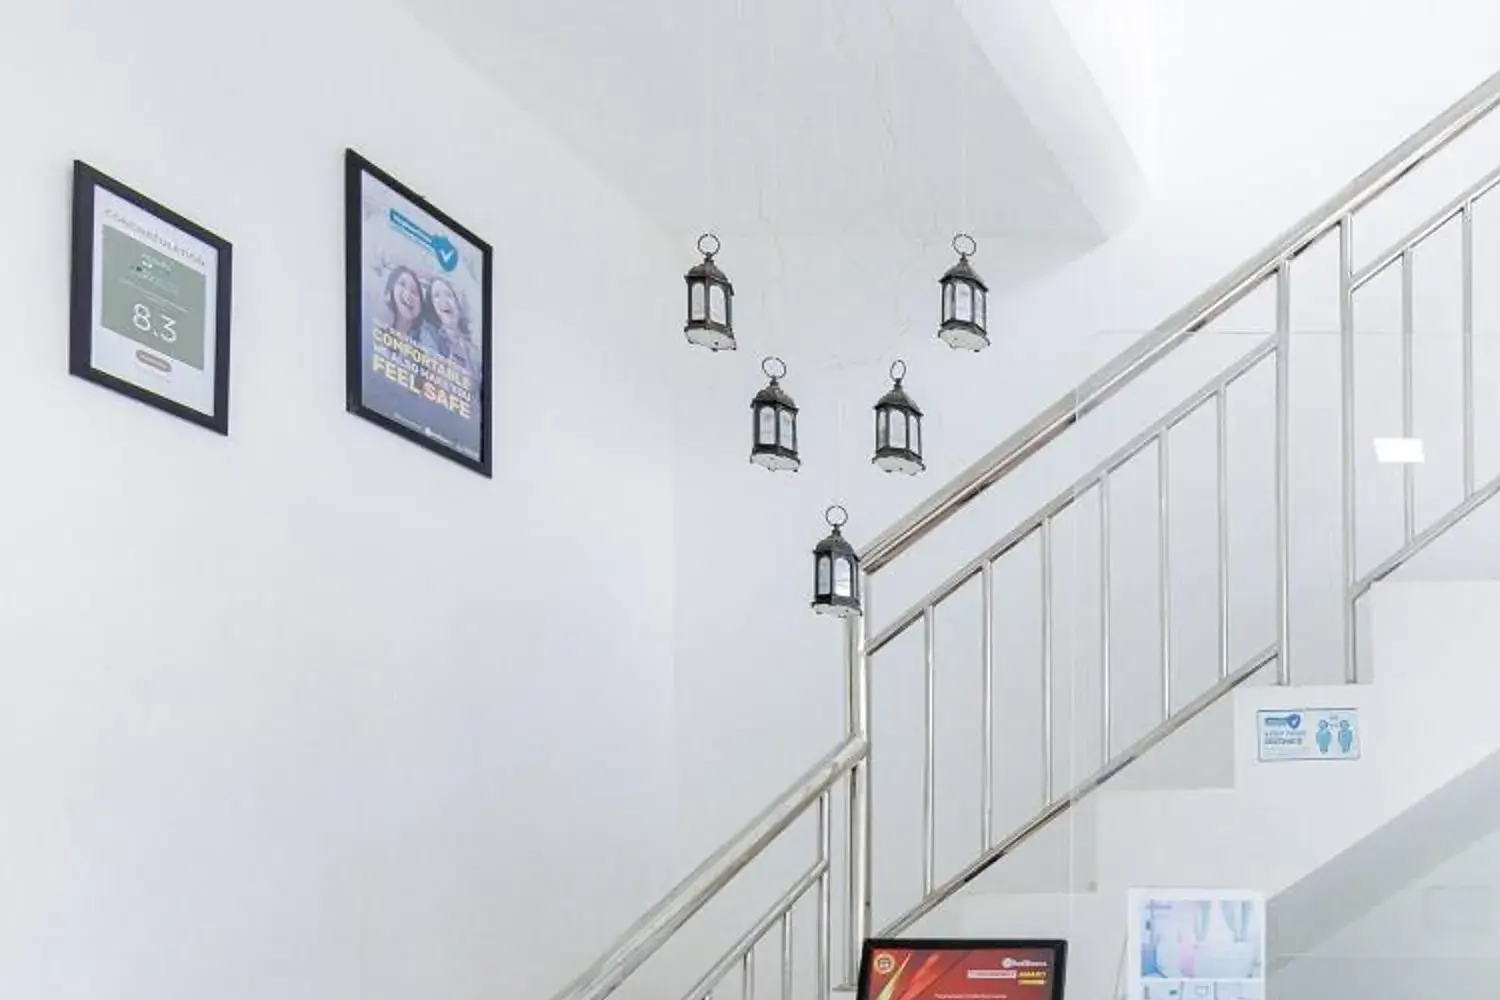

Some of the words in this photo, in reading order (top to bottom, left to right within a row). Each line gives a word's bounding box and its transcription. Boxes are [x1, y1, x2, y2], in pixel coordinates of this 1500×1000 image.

[133, 302, 177, 343] 8.3
[372, 327, 472, 390] COMFORTABLE
[373, 354, 421, 397] FEEL
[422, 381, 472, 420] SAFE
